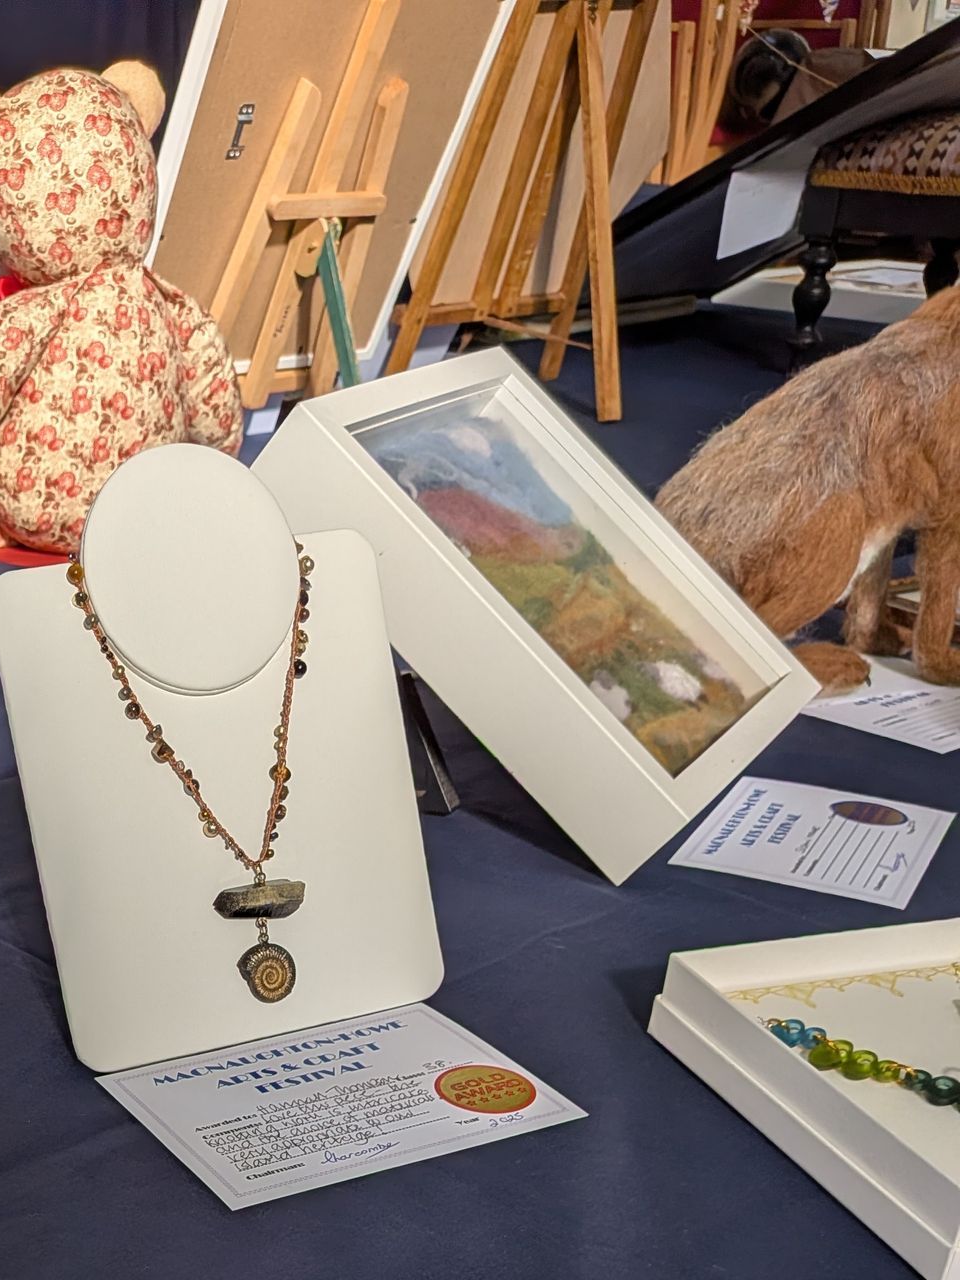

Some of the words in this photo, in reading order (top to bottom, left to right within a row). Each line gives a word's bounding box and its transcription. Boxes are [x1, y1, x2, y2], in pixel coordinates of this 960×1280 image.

[153, 1019, 408, 1086] MACNAUGHTON-HOWE
[217, 1066, 278, 1089] ARTS
[280, 1063, 301, 1074] &
[303, 1042, 381, 1067] CRAFT
[255, 1061, 373, 1094] FESTIVAL
[450, 1073, 505, 1091] GOLD
[454, 1078, 522, 1102] AWARD
[455, 1117, 480, 1126] Year
